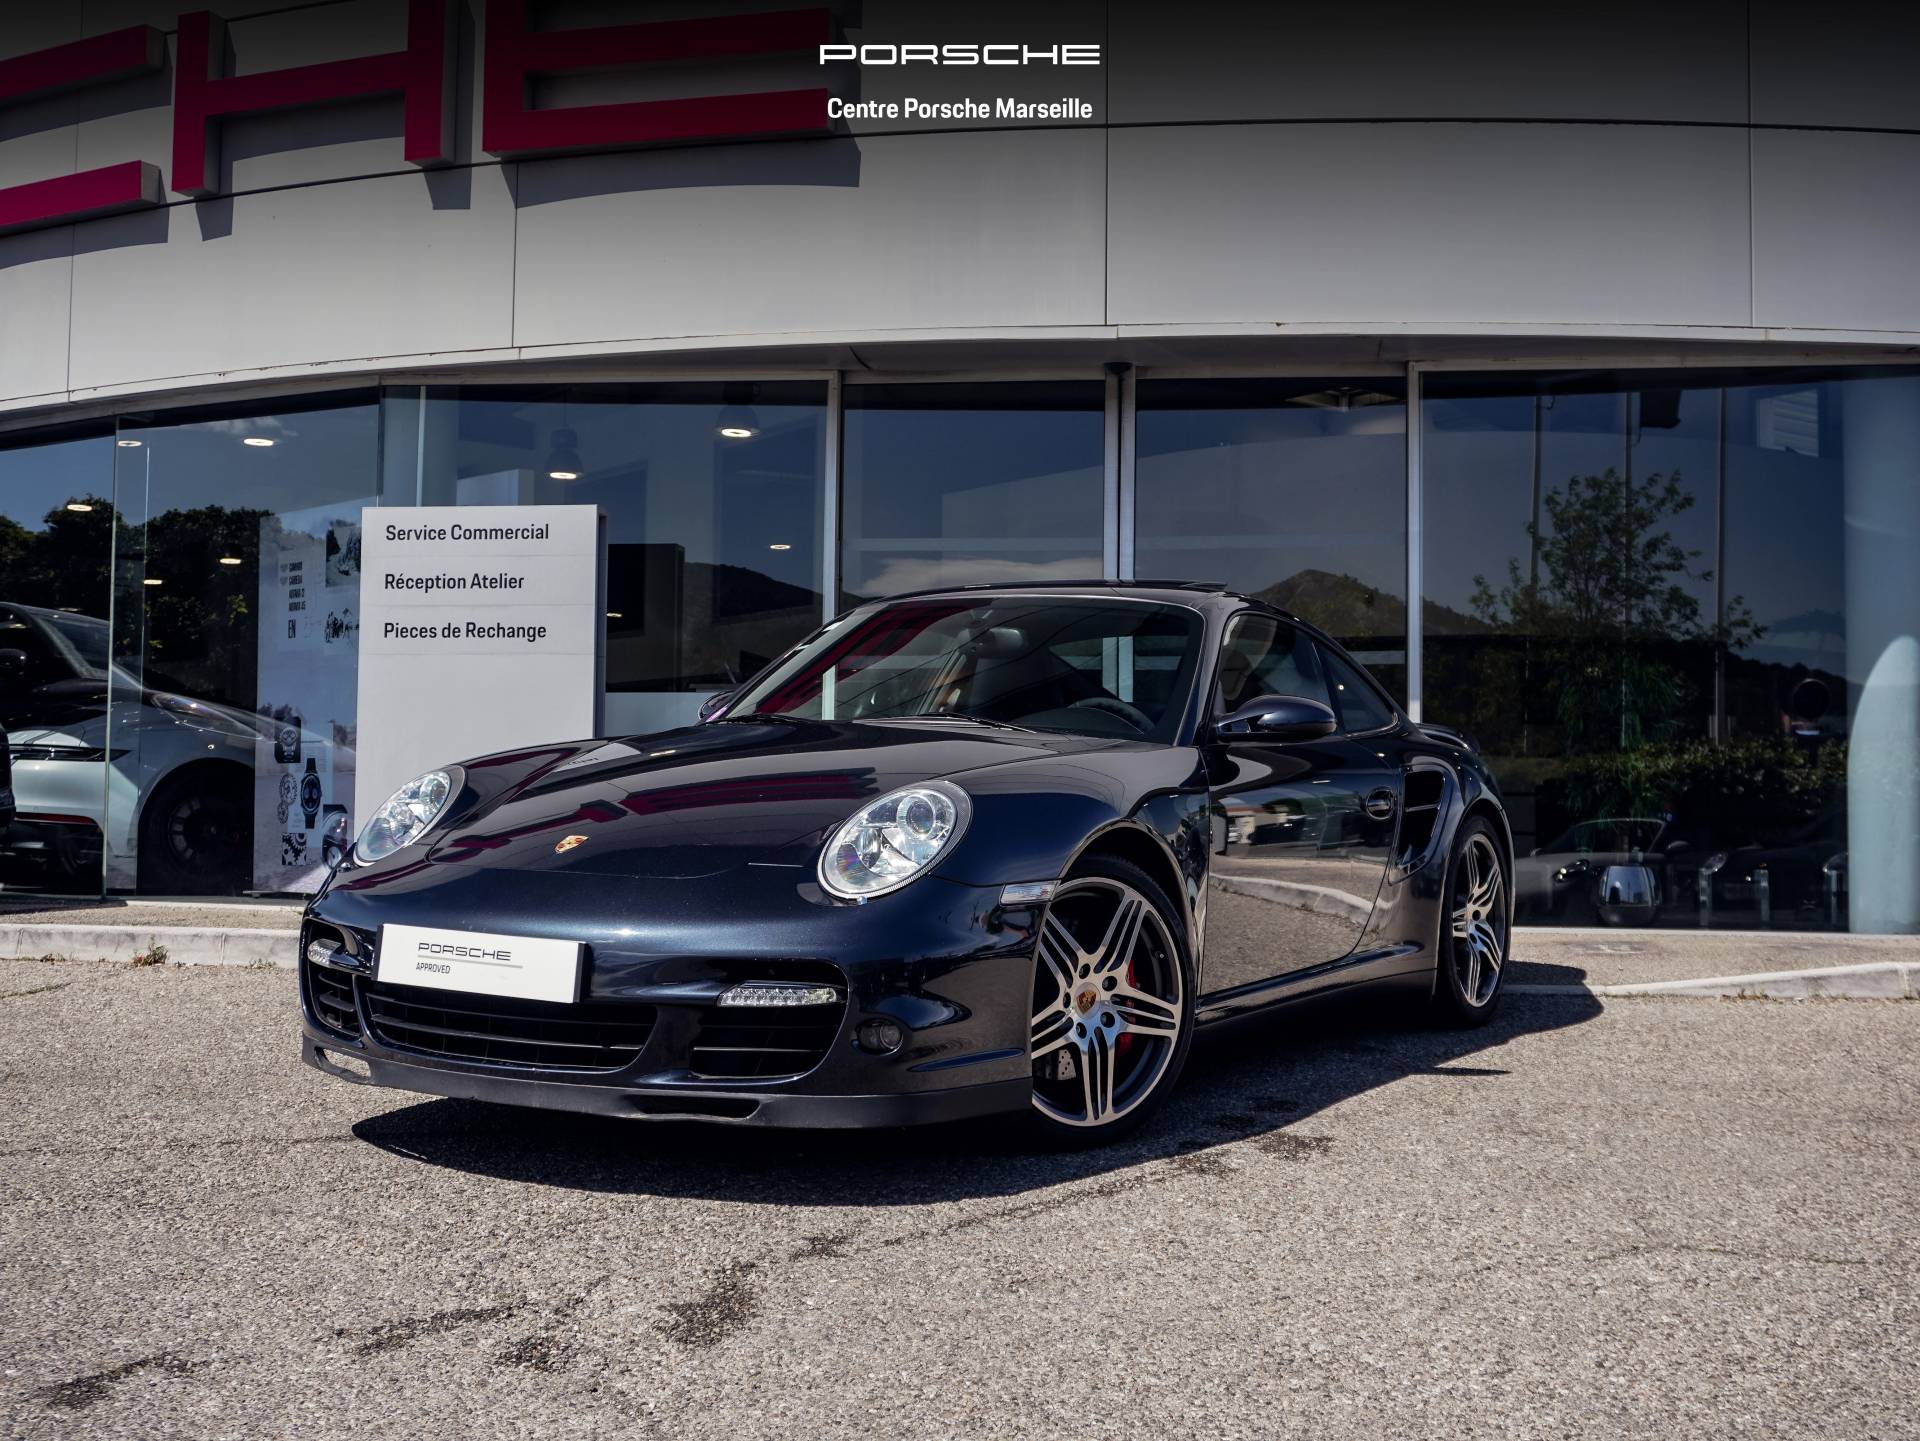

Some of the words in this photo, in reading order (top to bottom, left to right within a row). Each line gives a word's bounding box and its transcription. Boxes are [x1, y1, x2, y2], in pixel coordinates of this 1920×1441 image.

[385, 524, 447, 541] Service
[450, 523, 549, 541] Commercial
[384, 573, 467, 593] Réception
[470, 573, 525, 589] Atelier
[384, 622, 437, 639] Pieces
[441, 622, 462, 638] de
[465, 621, 547, 642] Rechange
[418, 942, 512, 961] PORSCHE
[415, 962, 451, 974] APPROVED
